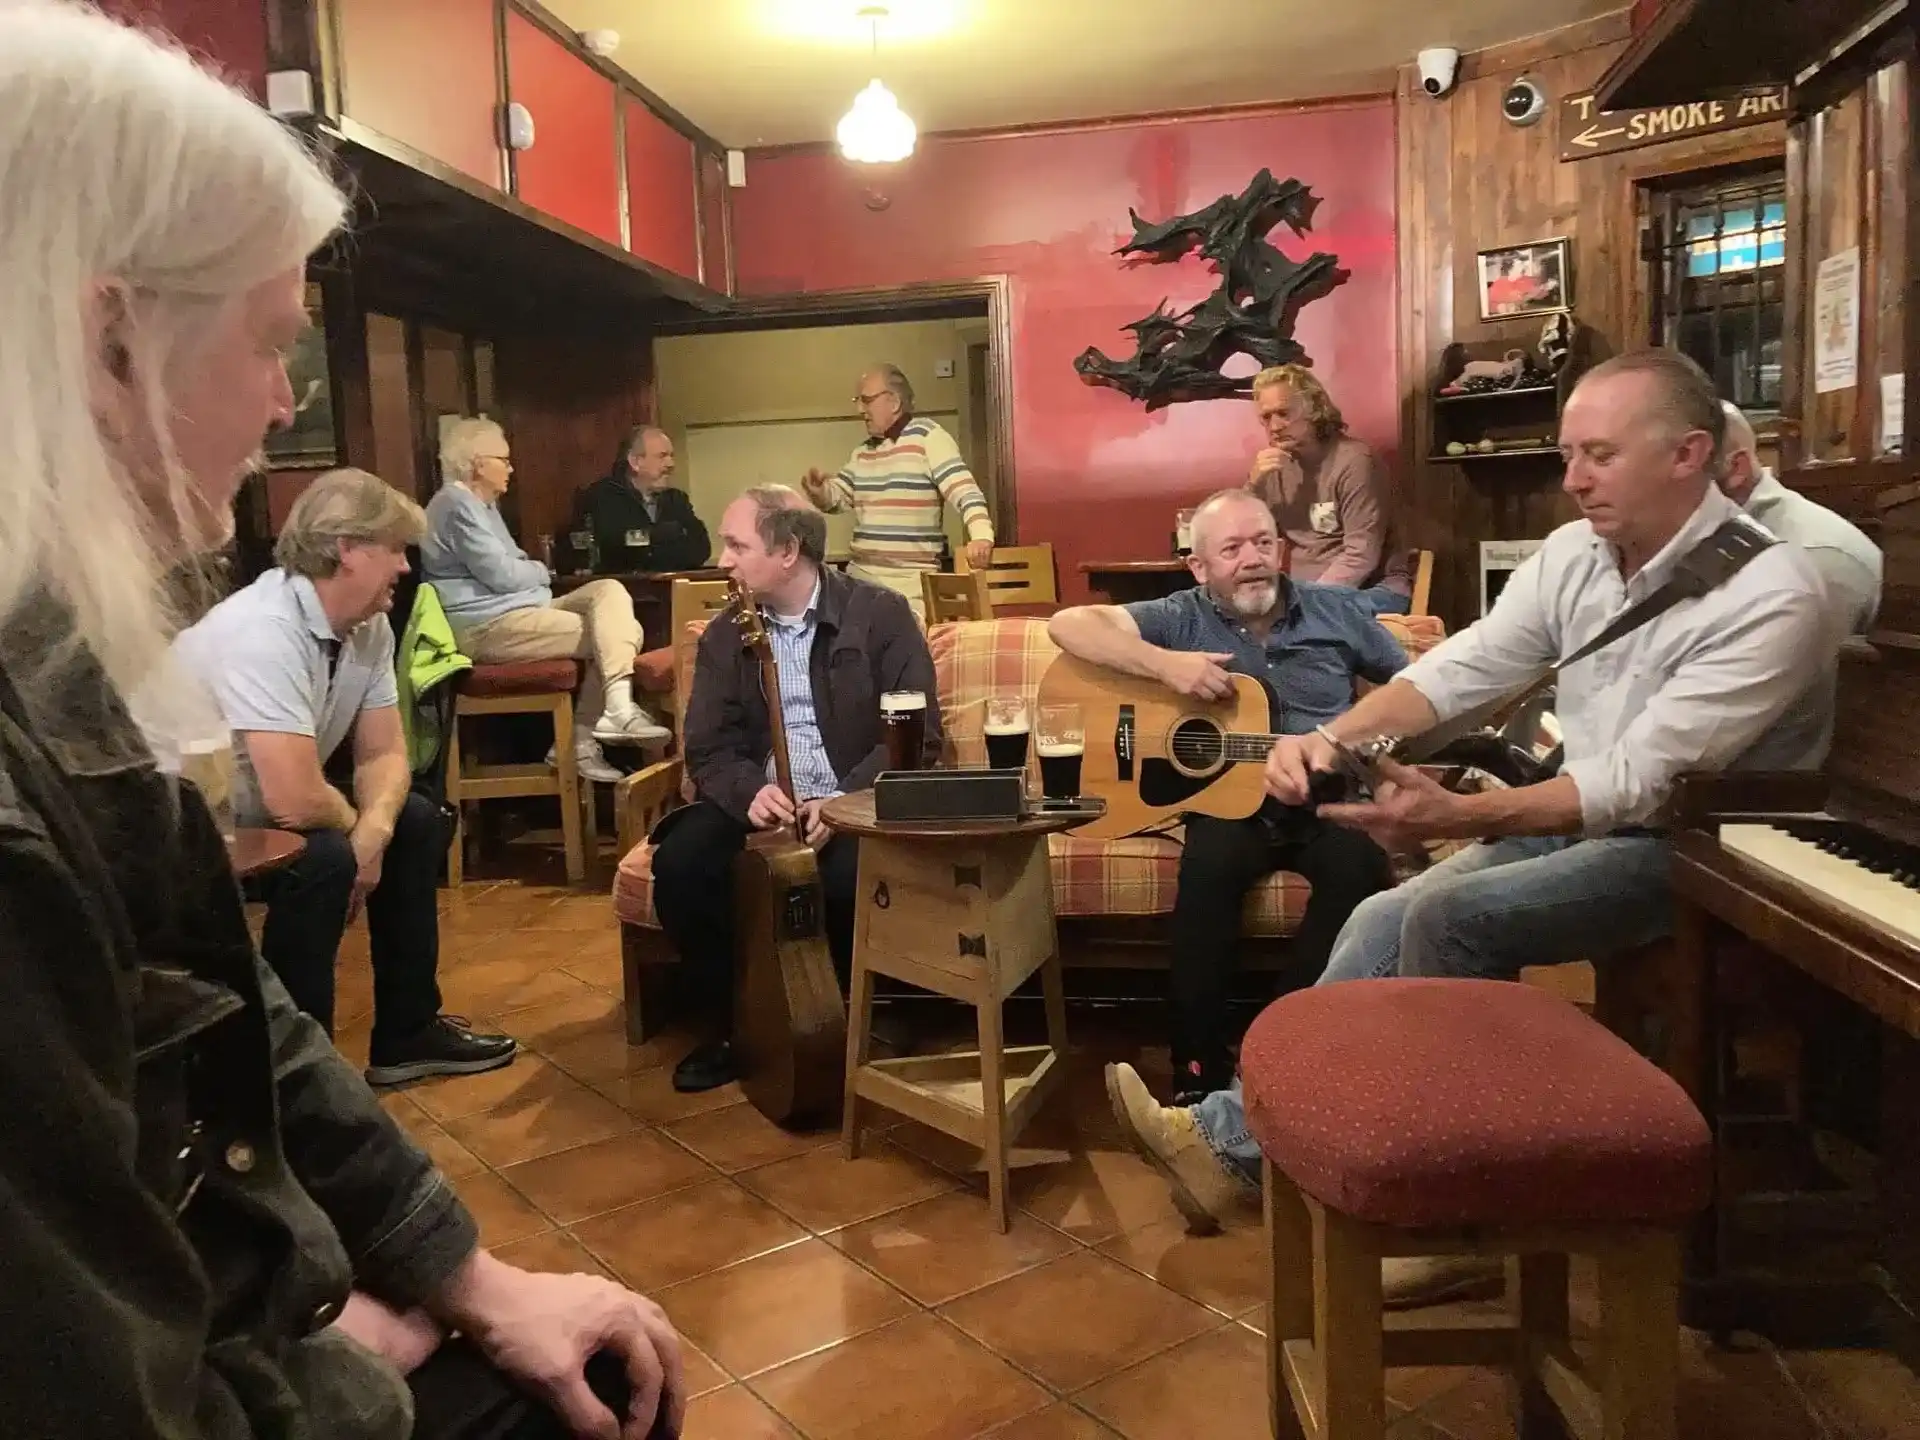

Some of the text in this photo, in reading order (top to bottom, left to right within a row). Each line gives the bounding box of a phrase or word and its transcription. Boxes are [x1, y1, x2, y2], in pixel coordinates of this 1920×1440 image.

[1571, 95, 1613, 120] T
[1627, 91, 1789, 139] SMOKE AR
